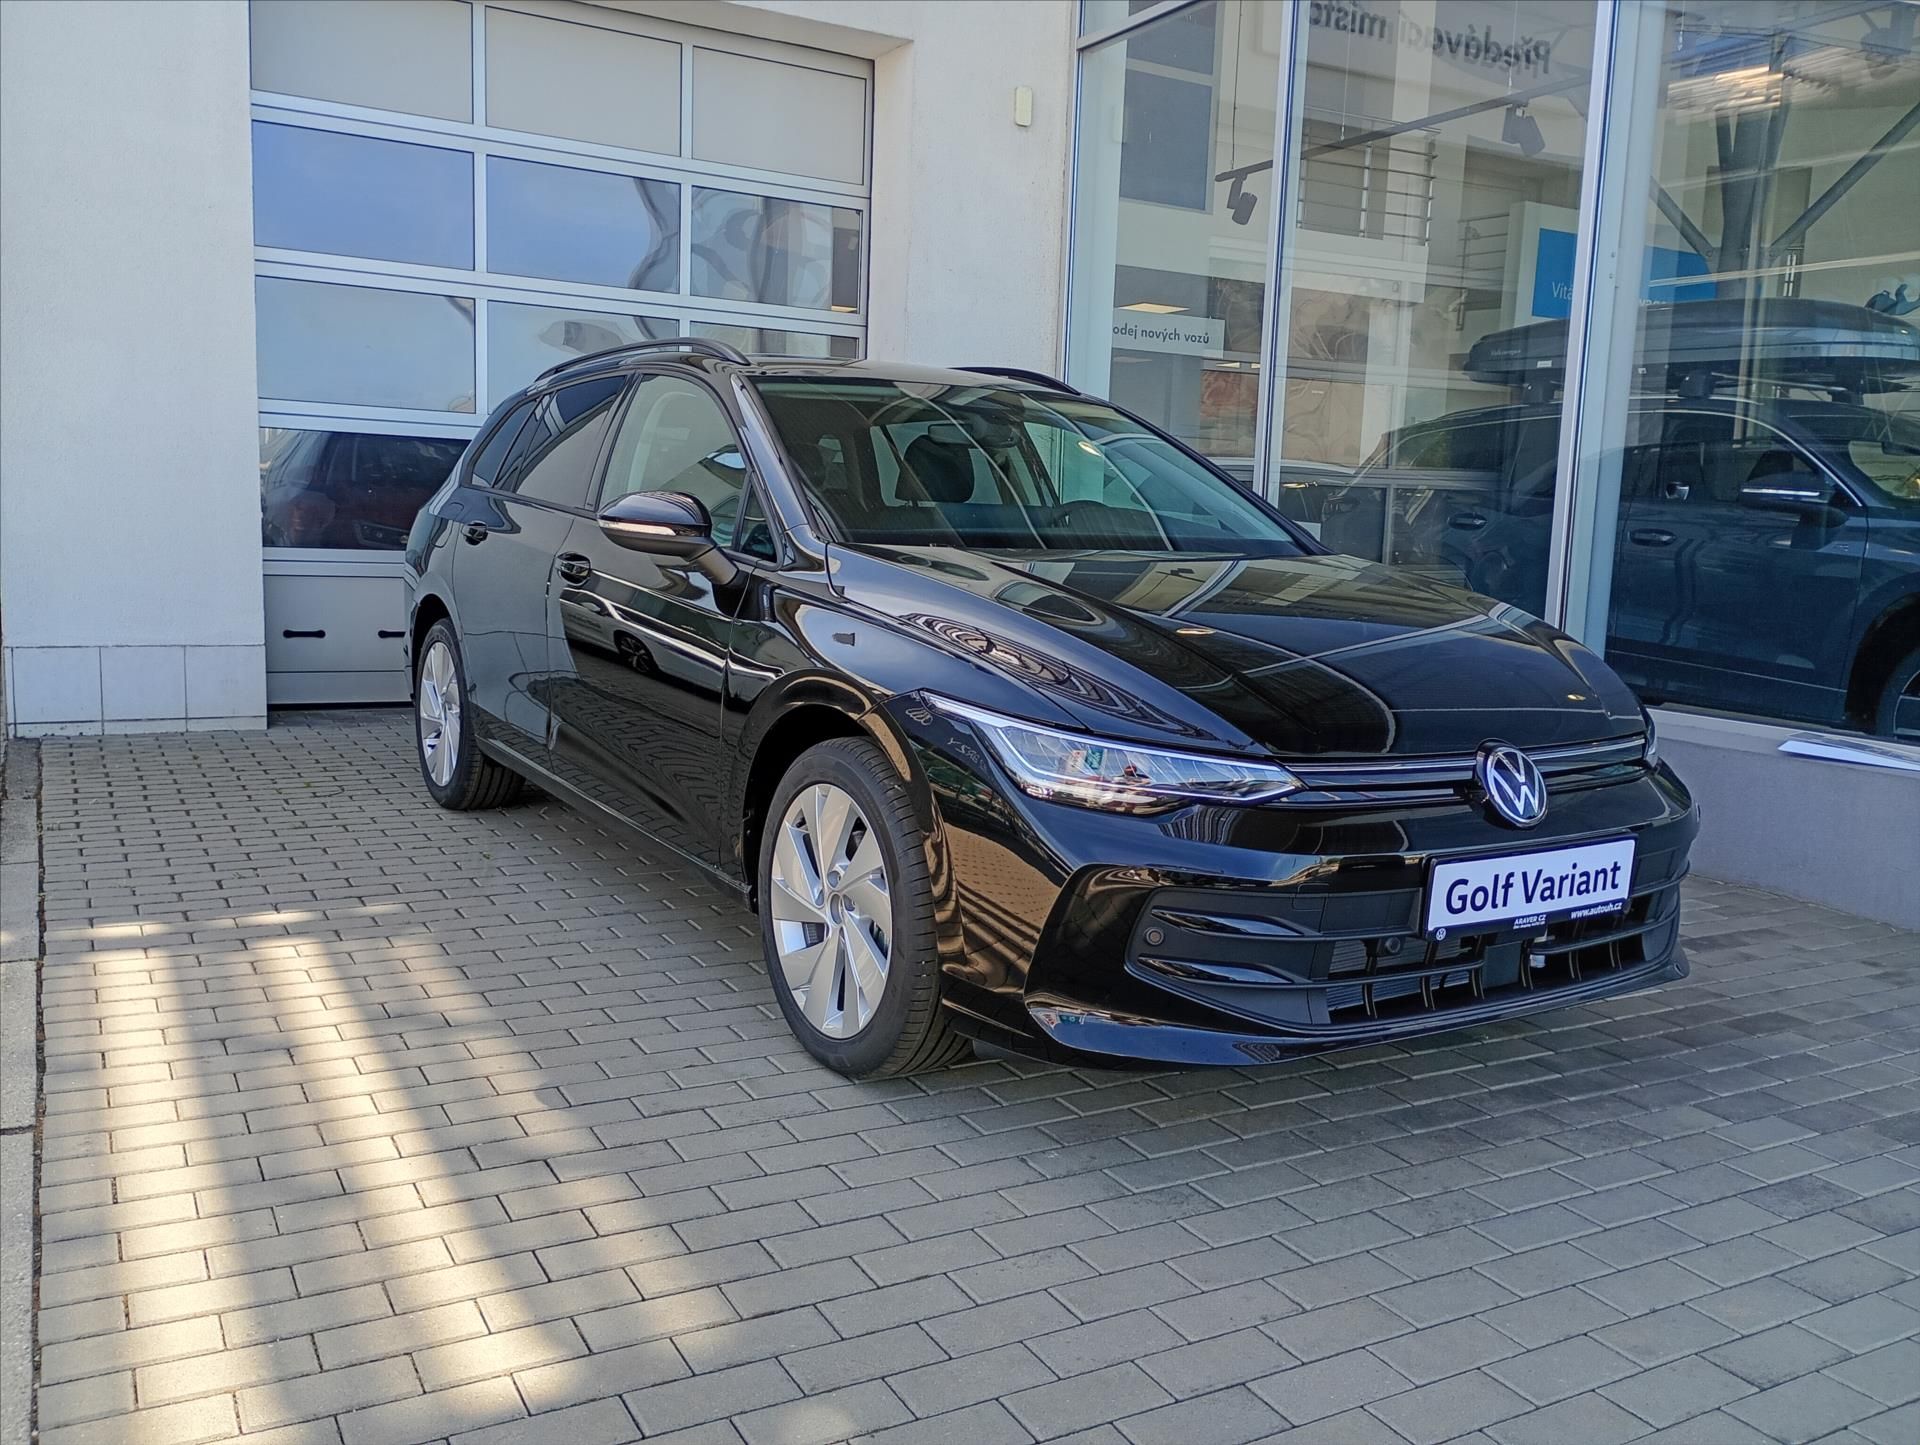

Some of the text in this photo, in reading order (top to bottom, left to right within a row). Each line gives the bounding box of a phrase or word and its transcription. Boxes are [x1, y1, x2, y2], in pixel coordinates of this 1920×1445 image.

[1113, 323, 1210, 344] odej nových vozů
[1445, 861, 1621, 915] Golf Variant
[1538, 914, 1547, 922] CZ
[1571, 902, 1623, 920] www.autouh.cz
